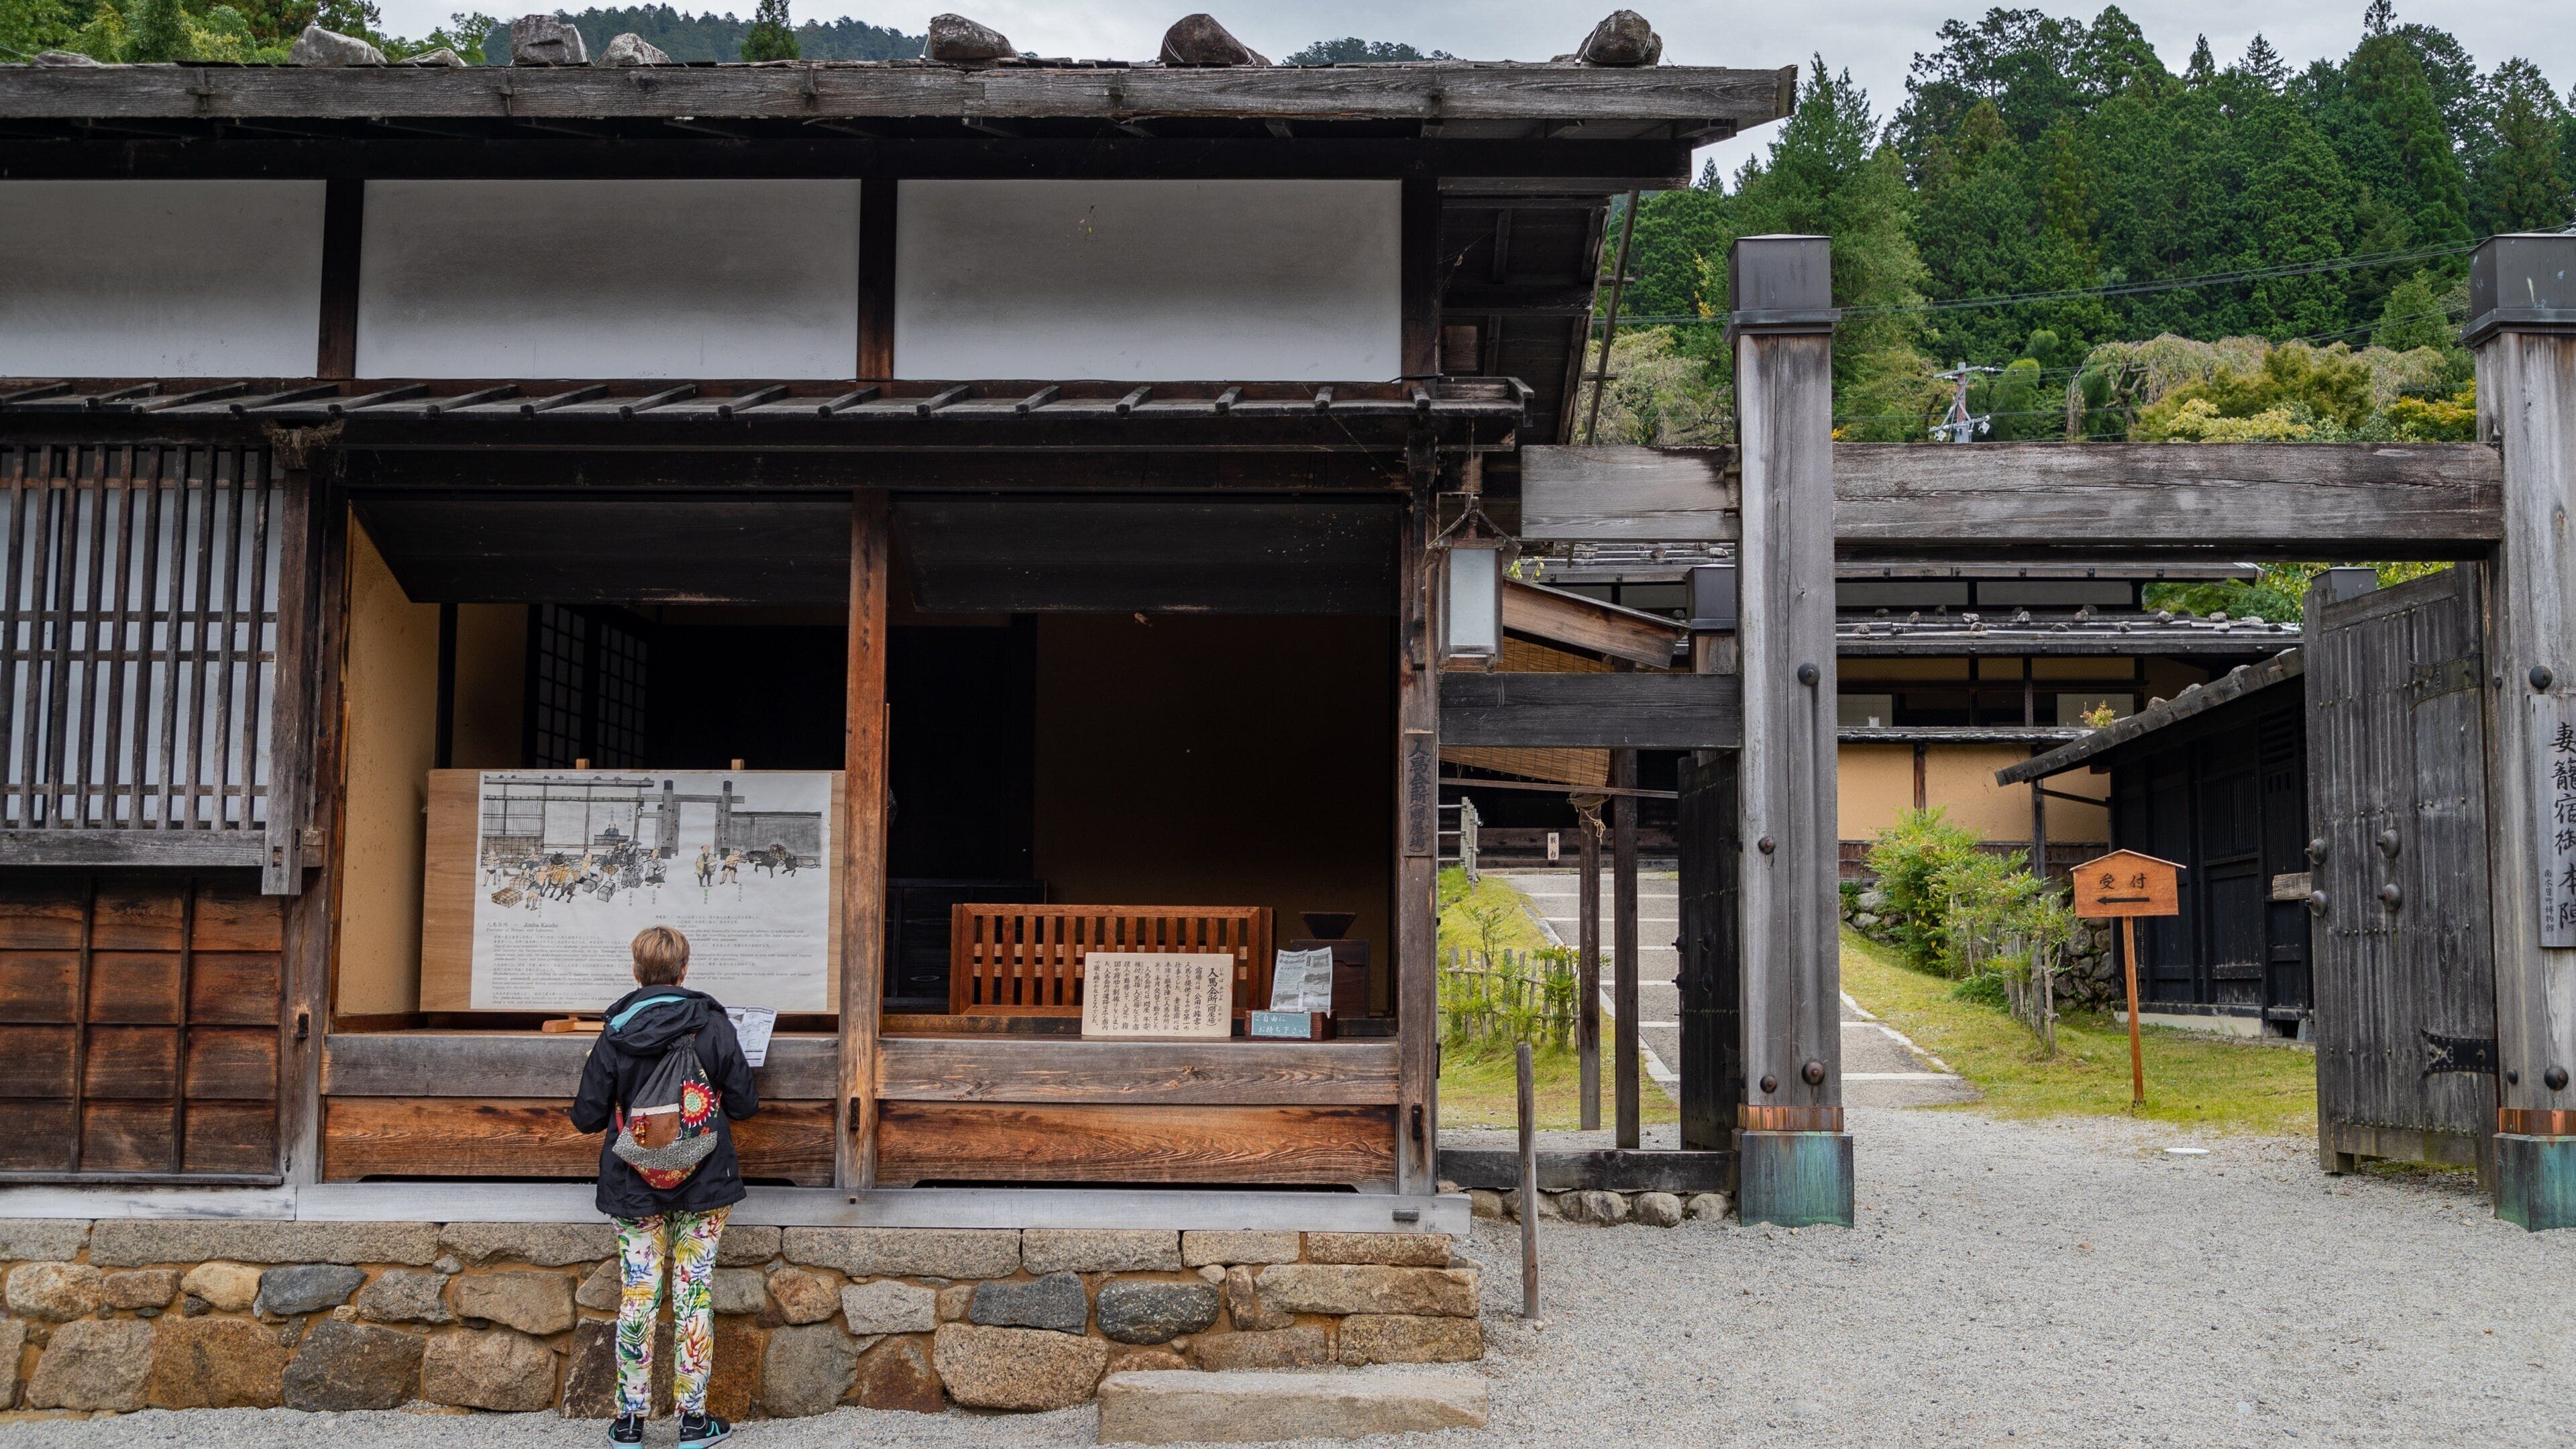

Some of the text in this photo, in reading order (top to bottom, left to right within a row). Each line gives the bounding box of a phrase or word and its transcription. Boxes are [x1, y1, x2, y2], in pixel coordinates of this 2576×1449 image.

[2099, 873, 2147, 890] 受付
[1255, 1014, 1286, 1022] ご自由に
